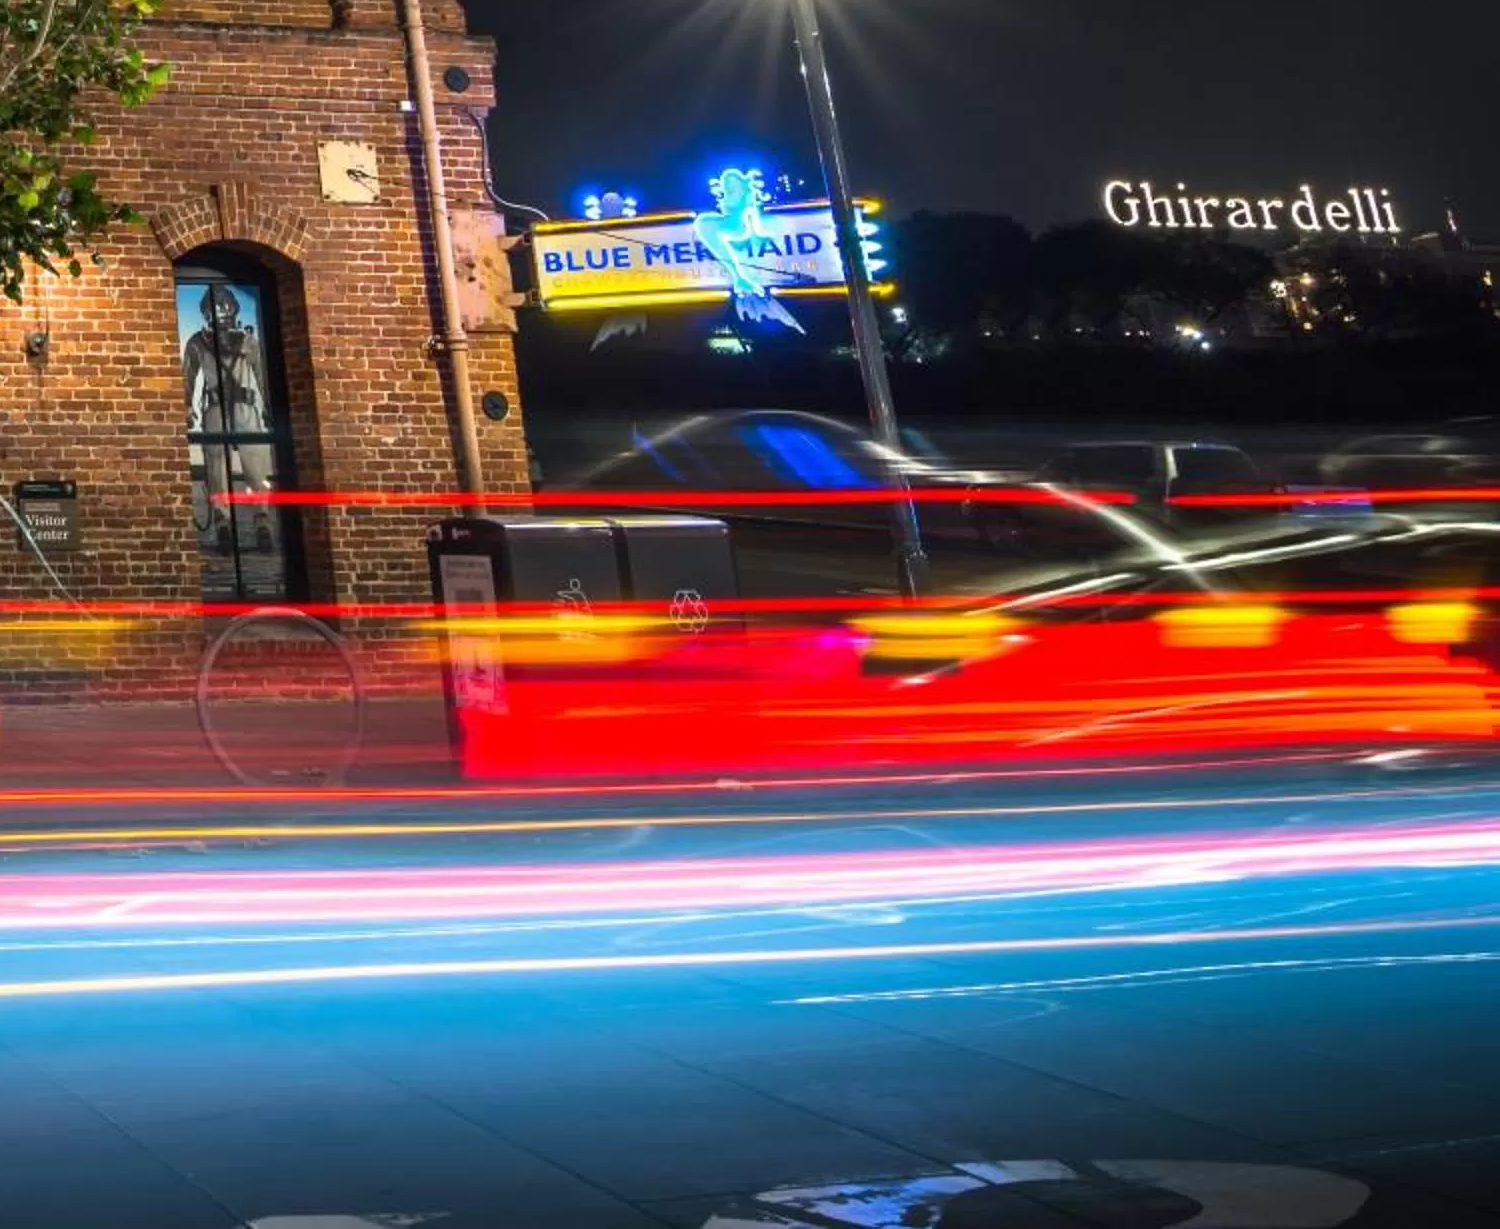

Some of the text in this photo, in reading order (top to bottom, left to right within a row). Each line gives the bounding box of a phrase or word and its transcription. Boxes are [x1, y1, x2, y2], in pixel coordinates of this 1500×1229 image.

[1104, 181, 1401, 233] Ghirardelli
[543, 246, 631, 273] BLUE
[25, 514, 68, 526] Visitor
[27, 528, 69, 540] Center
